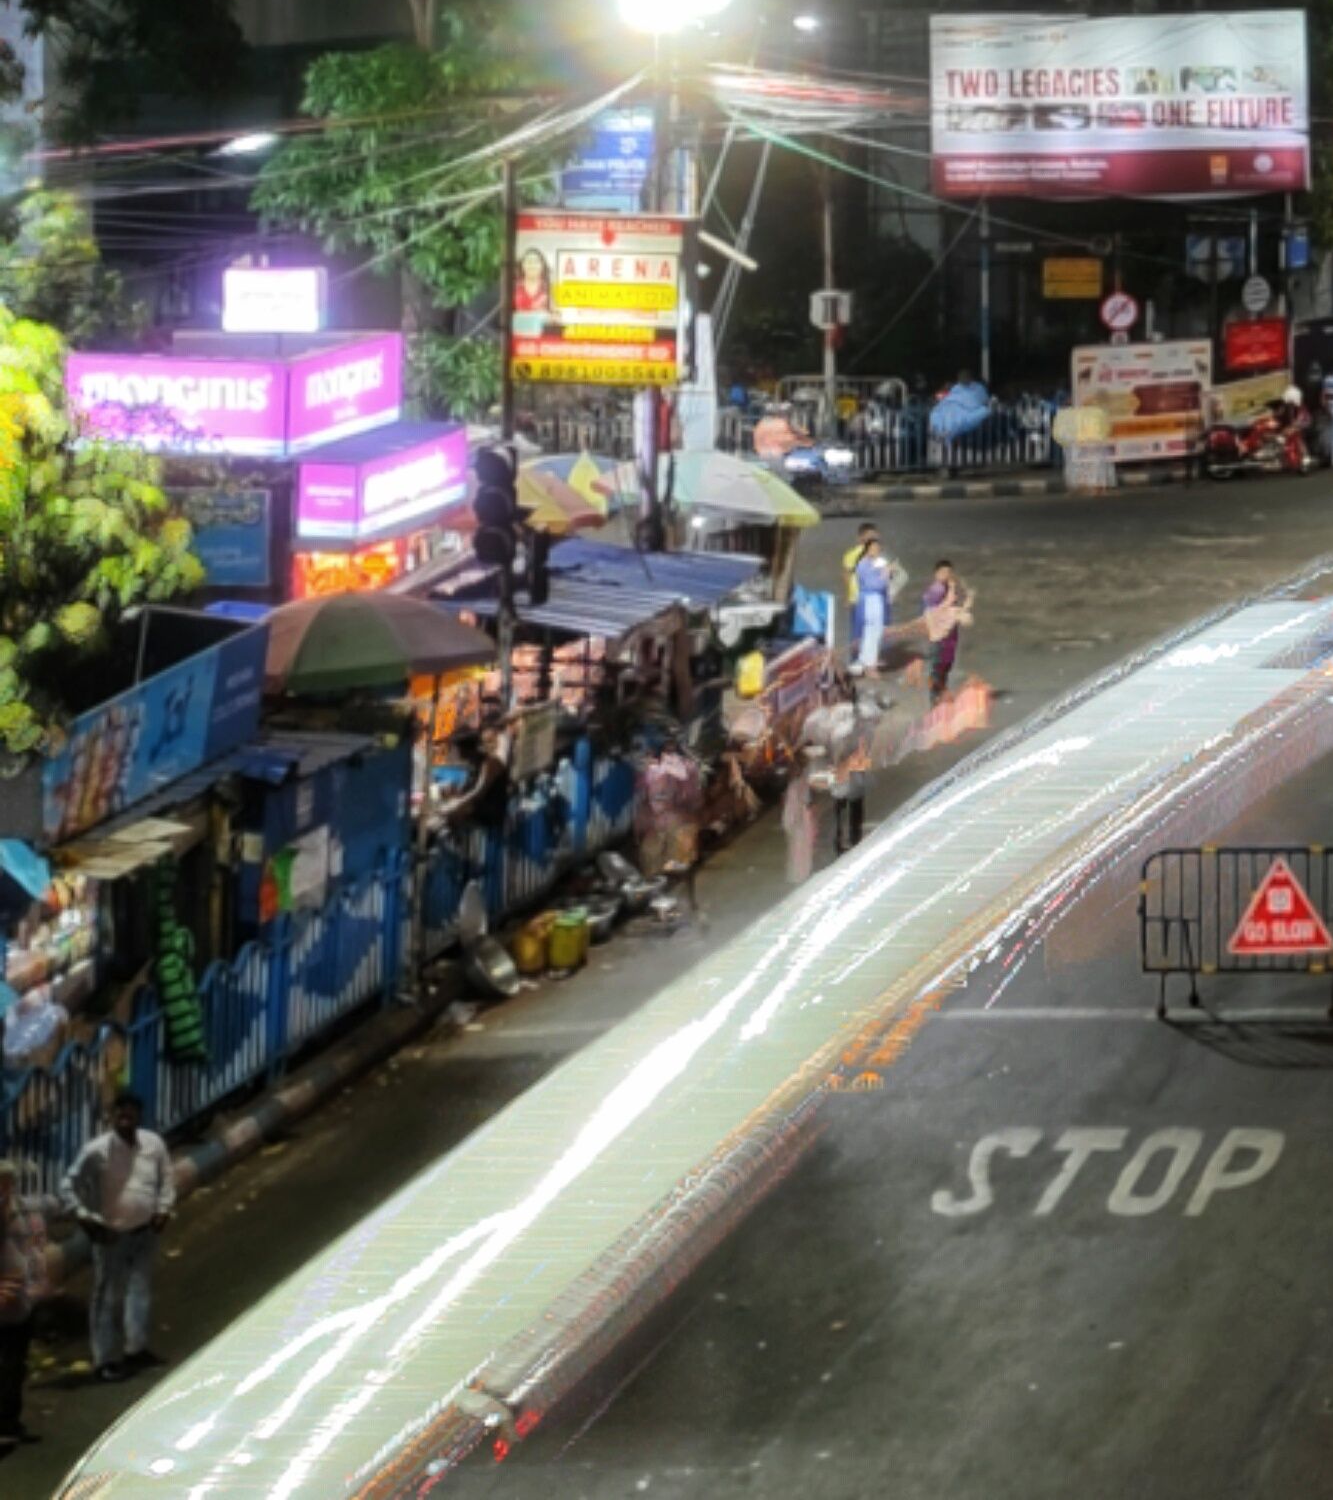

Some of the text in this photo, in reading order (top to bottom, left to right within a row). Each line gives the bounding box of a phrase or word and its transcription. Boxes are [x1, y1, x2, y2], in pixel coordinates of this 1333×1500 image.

[945, 67, 1121, 99] TWO LEGACIES
[1152, 96, 1293, 129] ONE FUTURE
[564, 256, 672, 280] ARENA
[562, 288, 674, 304] ANIMATION
[929, 1125, 1287, 1218] STOP
